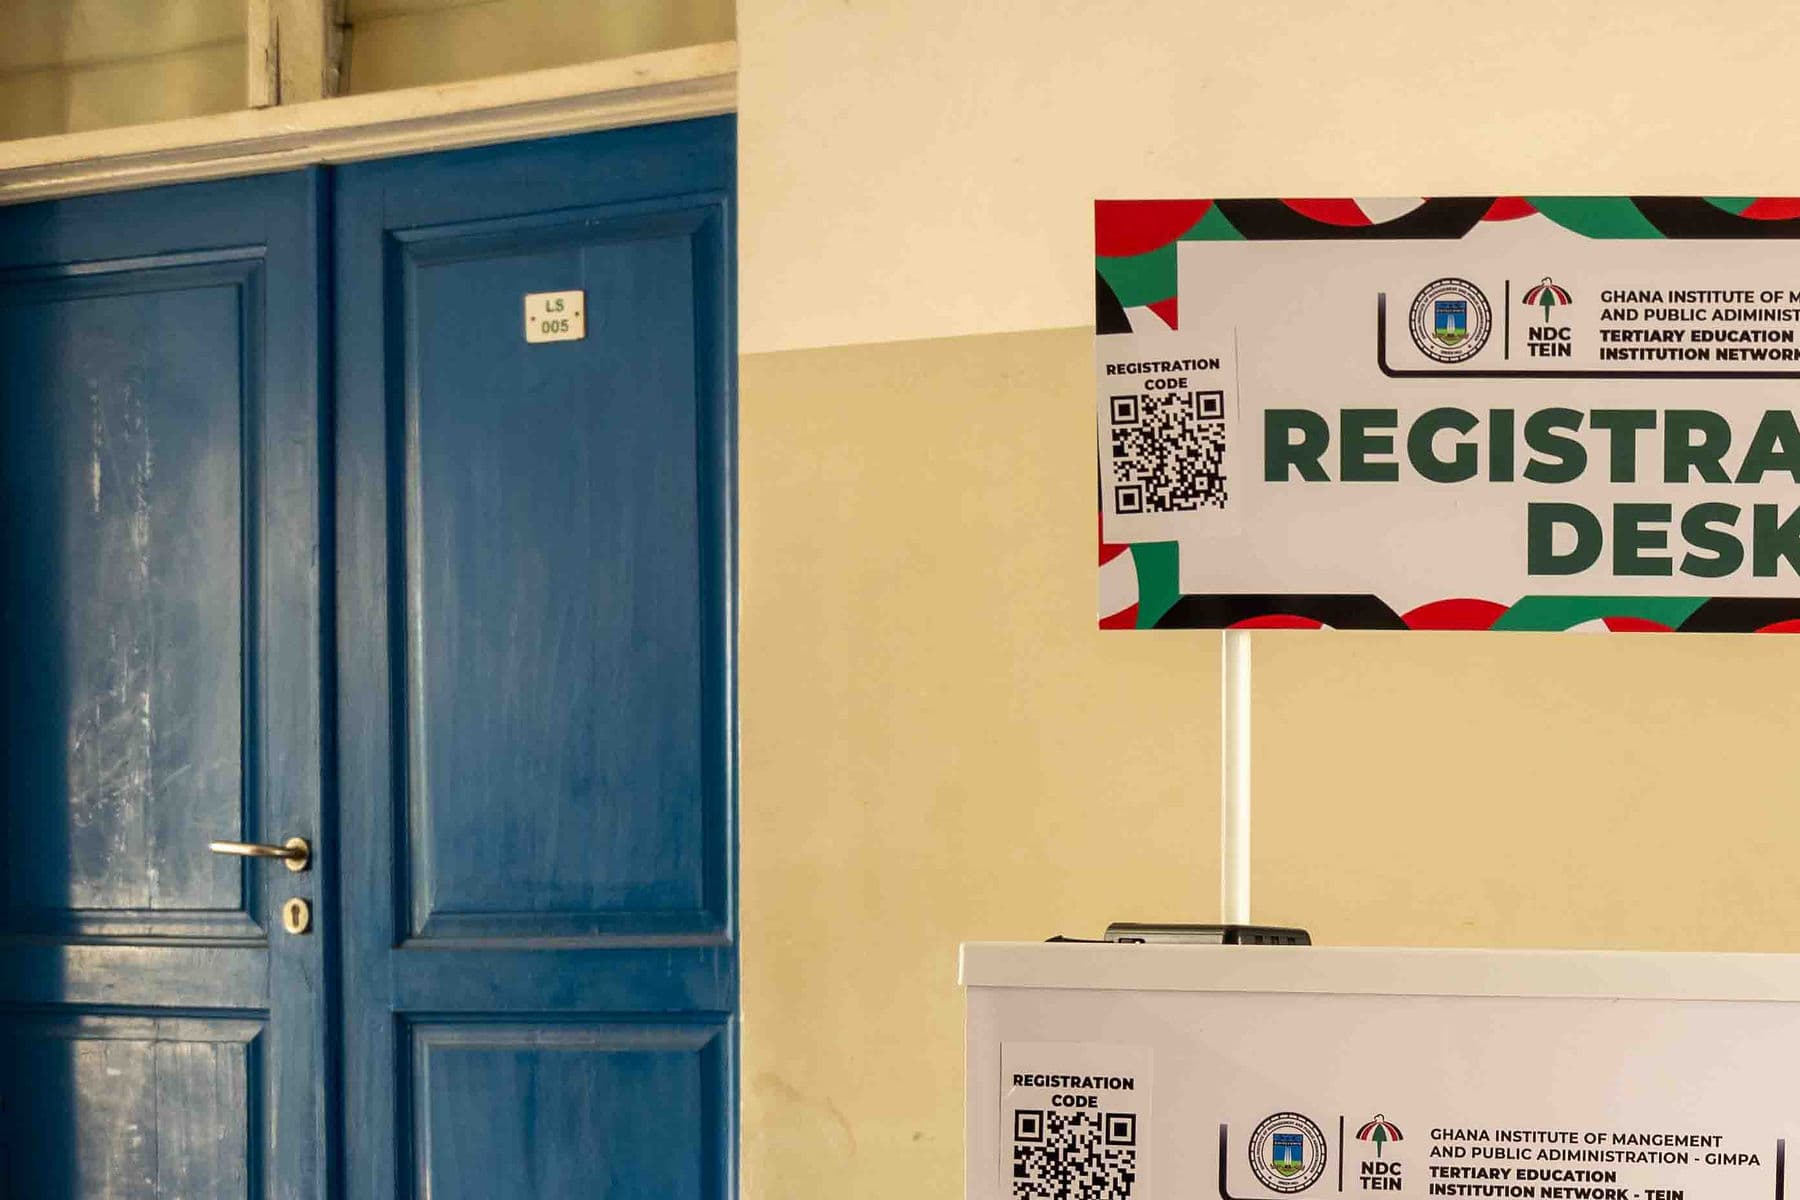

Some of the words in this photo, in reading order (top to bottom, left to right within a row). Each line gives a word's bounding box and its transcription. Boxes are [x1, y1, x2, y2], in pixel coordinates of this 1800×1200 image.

[1601, 290, 1663, 303] GHANA
[1669, 290, 1754, 304] INSTITUTE
[1760, 290, 1784, 303] OF
[546, 299, 564, 312] LS
[1600, 308, 1639, 321] AND
[1644, 308, 1707, 322] PUBLIC
[541, 319, 569, 333] 005
[1528, 327, 1571, 341] NDC
[1600, 329, 1685, 343] TERTIARY
[1691, 330, 1794, 343] EDUCATION
[1527, 343, 1571, 357] TEIN
[1600, 348, 1710, 360] INSTITUTION
[1106, 358, 1220, 375] REGISTRATION
[1144, 377, 1188, 390] CODE
[1013, 1074, 1134, 1090] REGISTRATION
[1052, 1094, 1098, 1108] CODE
[1431, 1128, 1490, 1142] GHANA
[1496, 1130, 1578, 1144] INSTITUTE
[1584, 1132, 1607, 1145] OF
[1612, 1133, 1722, 1148] MANGEMENT
[1430, 1146, 1466, 1158] AND
[1472, 1147, 1532, 1160] PUBLIC
[1537, 1148, 1688, 1164] ADIMINISTRATION
[1705, 1153, 1760, 1166] GIMPA
[1361, 1161, 1402, 1176] NDC
[1429, 1166, 1511, 1180] TERTIARY
[1516, 1168, 1616, 1183] EDUCATION
[1360, 1176, 1402, 1190] TEIN
[1429, 1183, 1535, 1198] INSTITUTION
[1541, 1186, 1628, 1200] NETWORK
